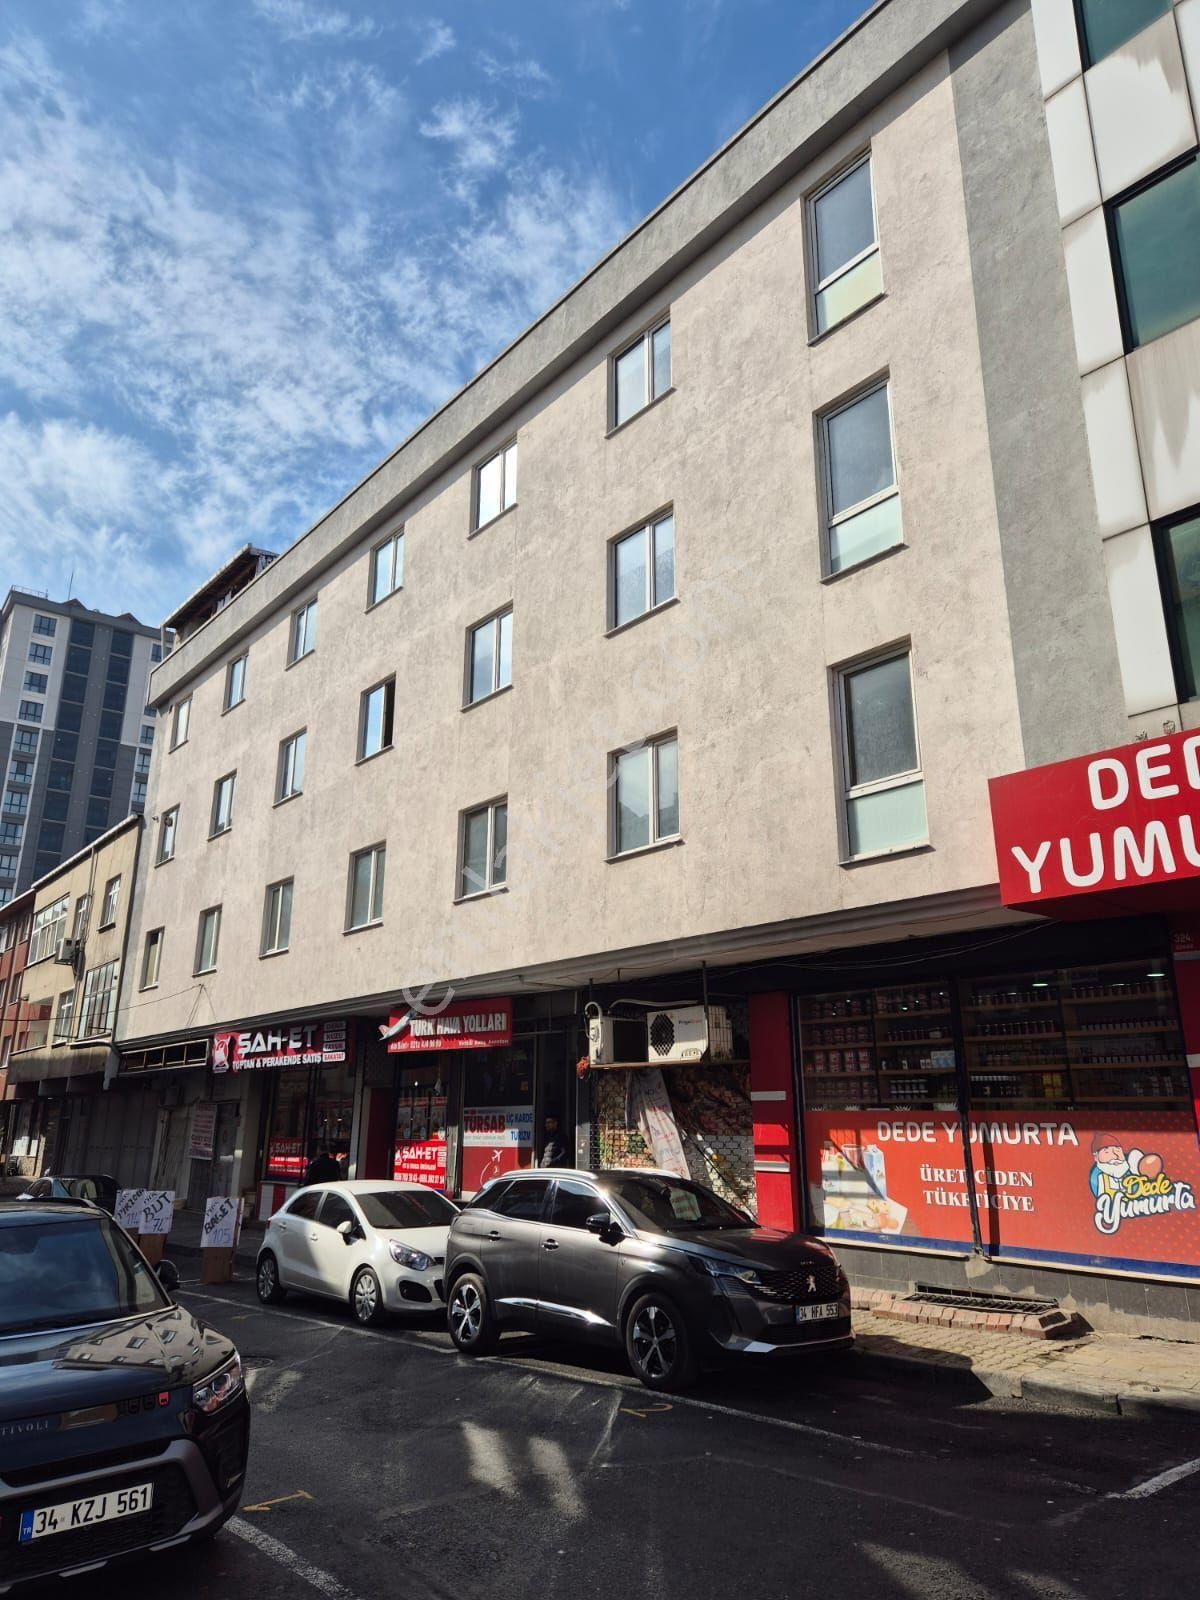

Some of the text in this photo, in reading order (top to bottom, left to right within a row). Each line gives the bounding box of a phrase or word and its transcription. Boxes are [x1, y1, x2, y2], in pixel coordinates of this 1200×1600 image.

[436, 1017, 461, 1035] HAVA
[463, 1013, 507, 1033] YOLLARI
[237, 1024, 318, 1058] ŞAH-ET
[232, 1053, 321, 1071] TOPTAN & PERAKENDE SATIŞ
[877, 1121, 937, 1142] DEDE
[402, 1146, 438, 1161] ŞAH-ET
[920, 1164, 1033, 1187] ÜRETCİDEN
[1122, 1173, 1172, 1199] Dede
[1094, 1181, 1196, 1234] Yumurta
[1, 1420, 50, 1436] TIVOLI
[35, 1487, 149, 1534] 34 KZJ 561
[23, 1526, 32, 1535] TR
